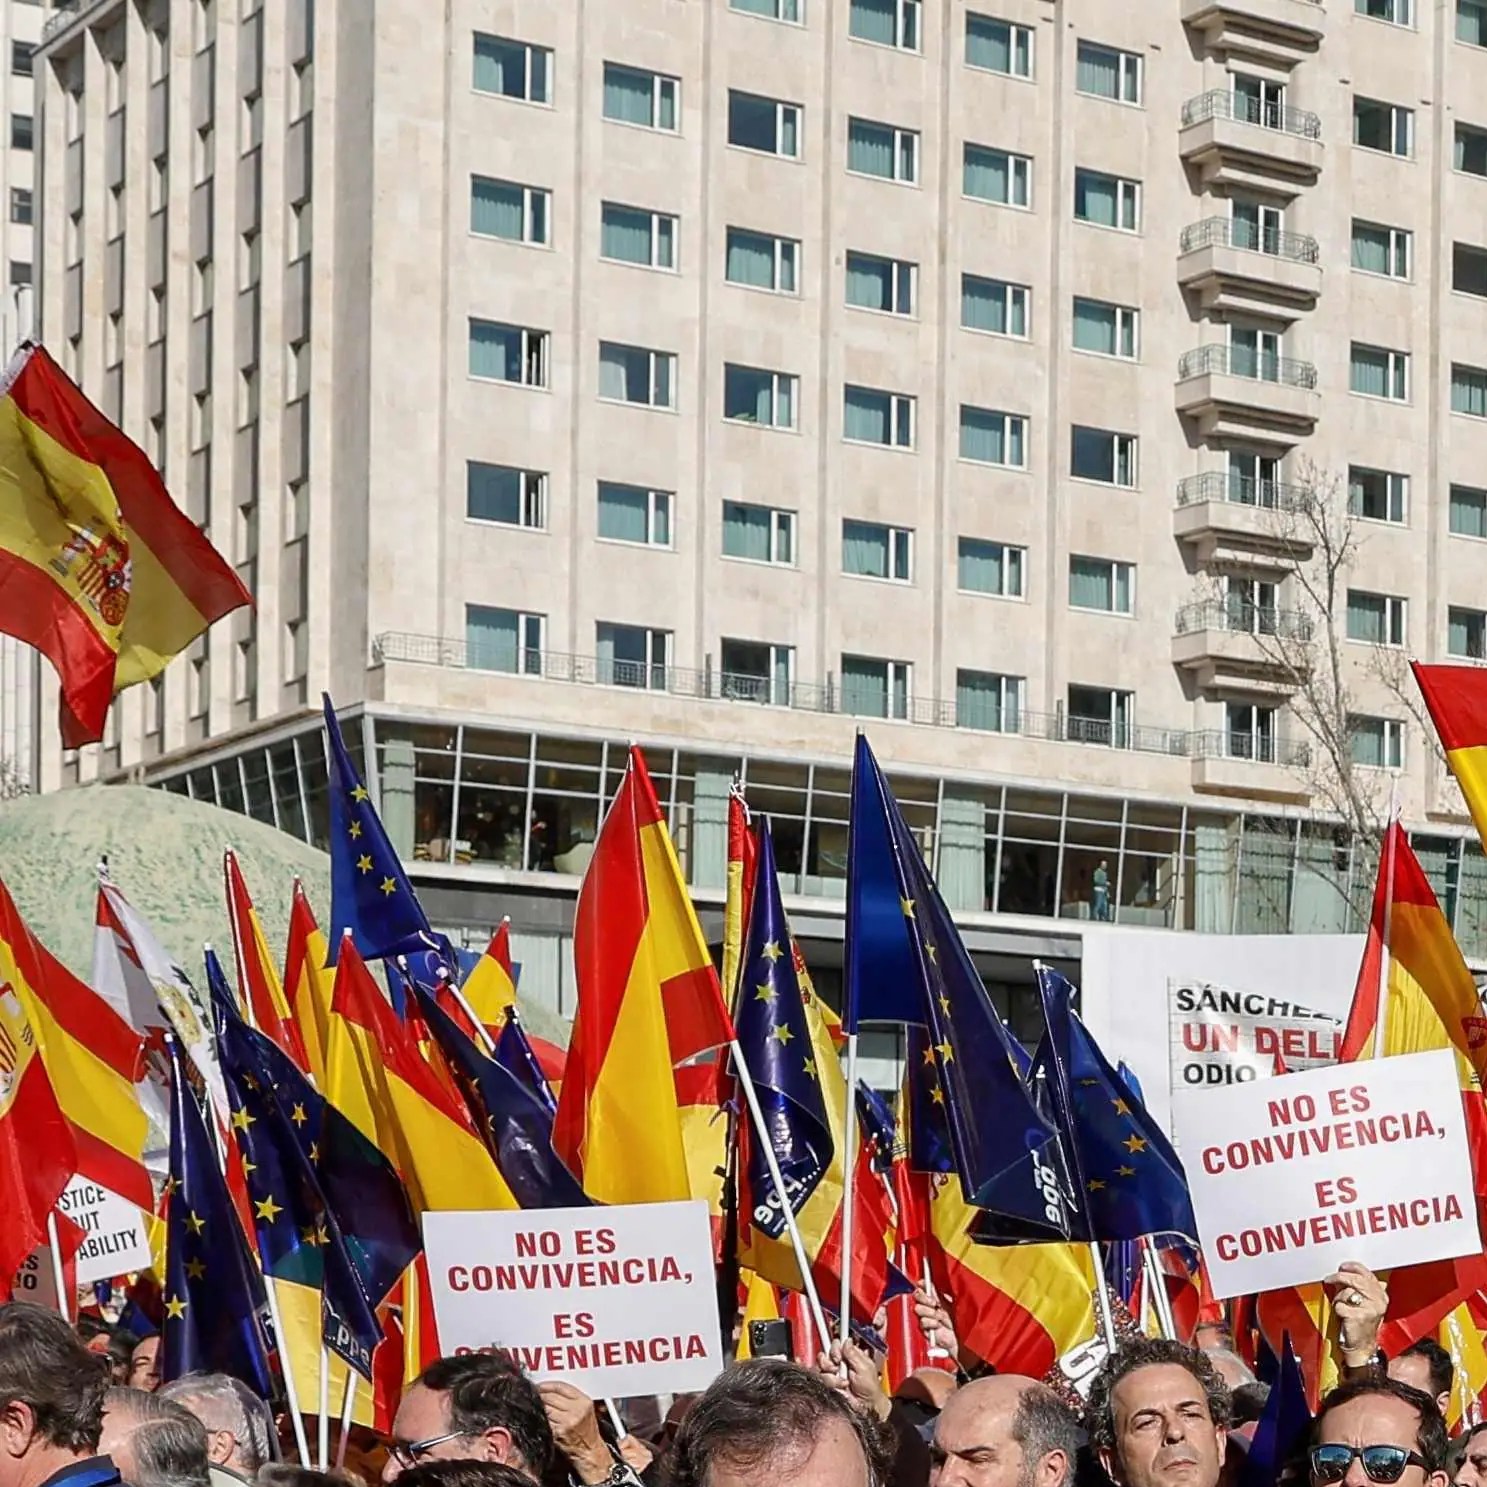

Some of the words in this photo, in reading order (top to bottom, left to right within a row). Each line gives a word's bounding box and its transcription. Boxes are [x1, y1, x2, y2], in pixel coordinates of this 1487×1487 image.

[1182, 1023, 1238, 1052] UN
[1267, 1093, 1316, 1128] NO
[1327, 1085, 1370, 1117] ES
[1202, 1110, 1446, 1175] CONVIVENCIA,
[56, 1186, 106, 1211] STICE
[1314, 1176, 1358, 1208] ES
[515, 1231, 561, 1258] NO
[574, 1228, 616, 1255] ES
[1215, 1193, 1463, 1262] CONVENIENCIA
[448, 1256, 693, 1292] CONVIVENCIA,
[553, 1312, 595, 1340] ES
[455, 1335, 707, 1376] NVENIENCIA
